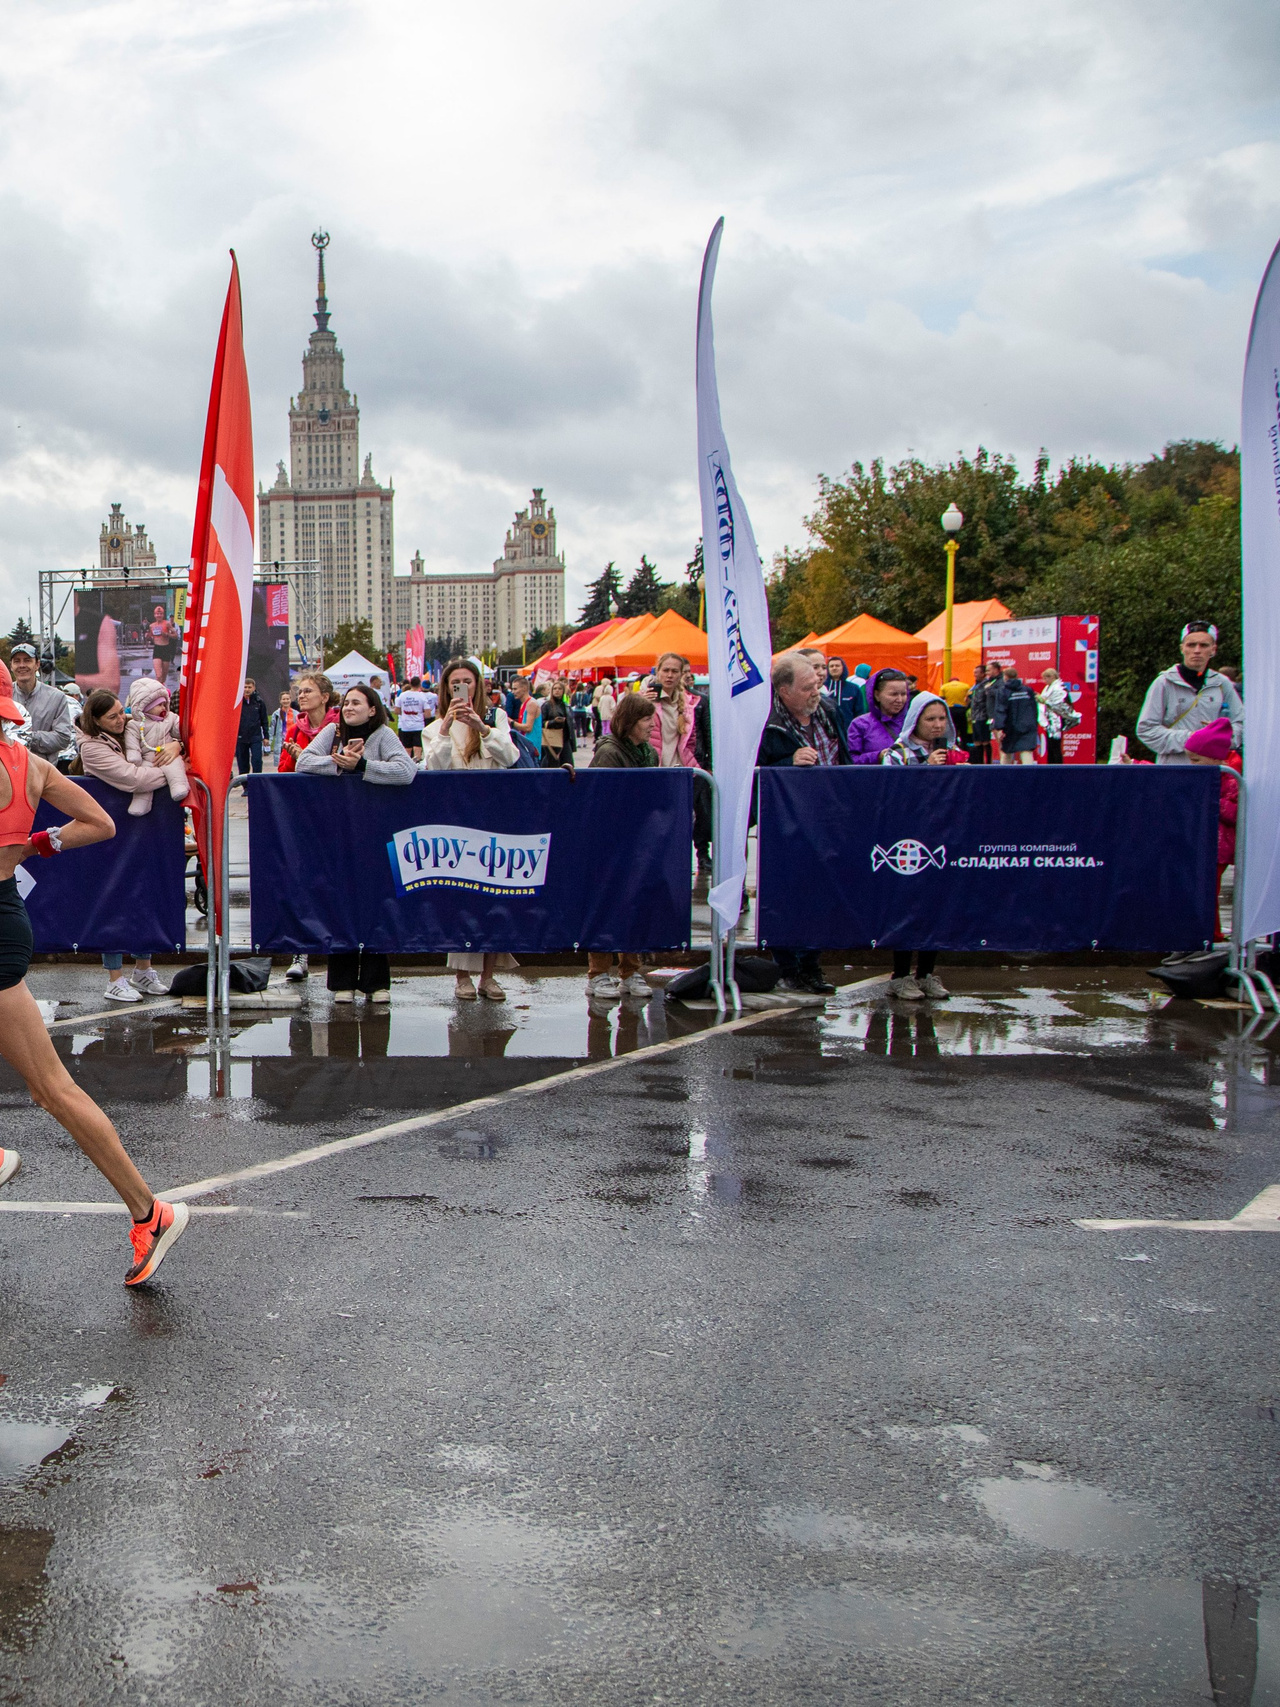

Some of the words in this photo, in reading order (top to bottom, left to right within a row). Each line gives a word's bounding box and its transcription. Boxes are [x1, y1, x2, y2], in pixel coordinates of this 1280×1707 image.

[403, 831, 545, 879] фру-фру
[978, 843, 1017, 854] группа
[1020, 842, 1077, 852] компаний
[950, 857, 1030, 870] «СЛАДКАЯ
[1033, 857, 1104, 868] СКАЗКА»
[405, 879, 480, 892] жевательный
[482, 885, 536, 895] мармелад
